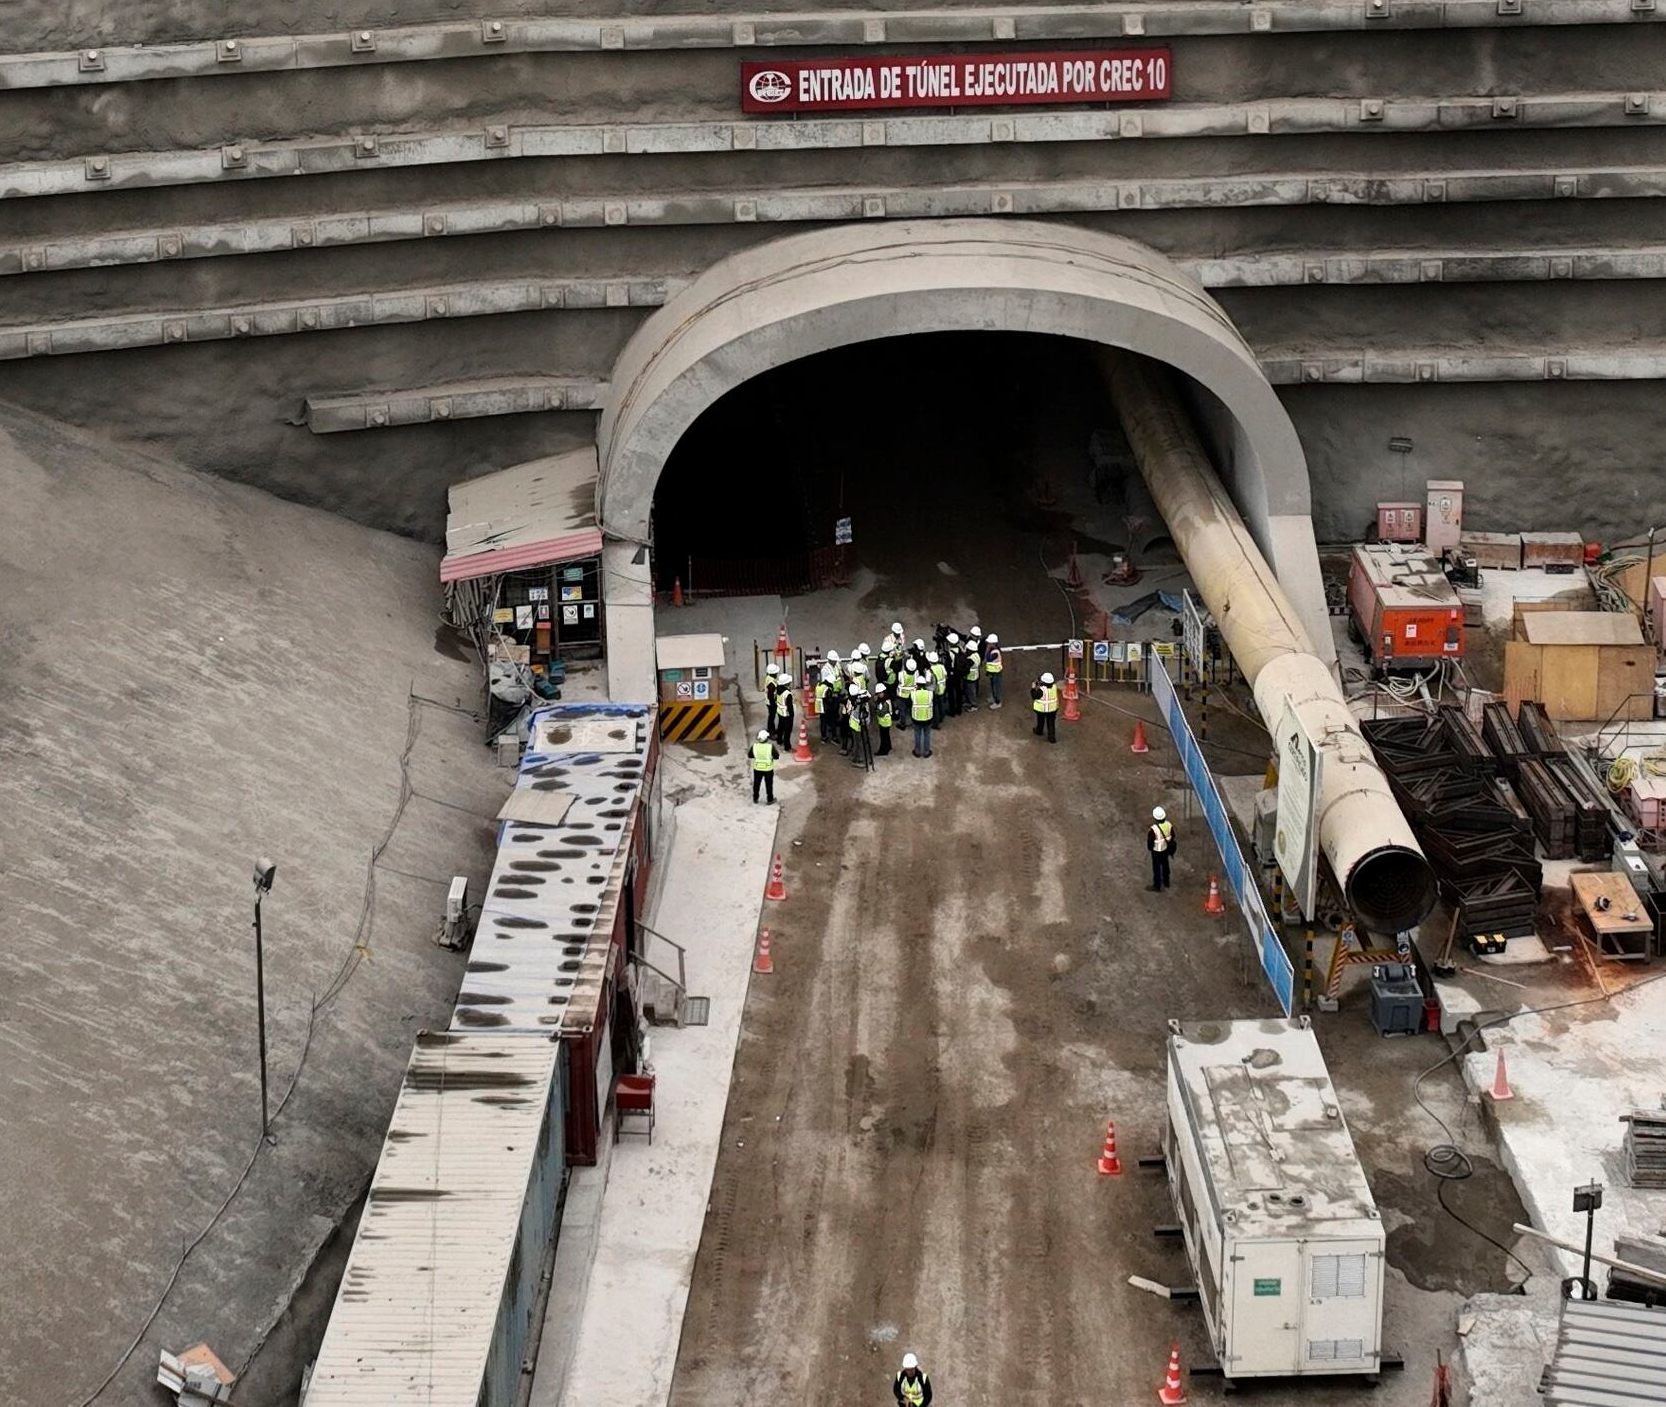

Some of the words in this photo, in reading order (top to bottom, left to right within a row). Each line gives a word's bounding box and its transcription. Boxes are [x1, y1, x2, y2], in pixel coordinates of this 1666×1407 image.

[799, 68, 876, 102] ENTRADA
[880, 67, 902, 99] DE
[905, 60, 960, 98] TÚNEL
[964, 62, 1059, 96] EJECUTADA
[1062, 61, 1096, 93] POR
[1099, 59, 1143, 92] CREC
[1146, 58, 1165, 90] 10
